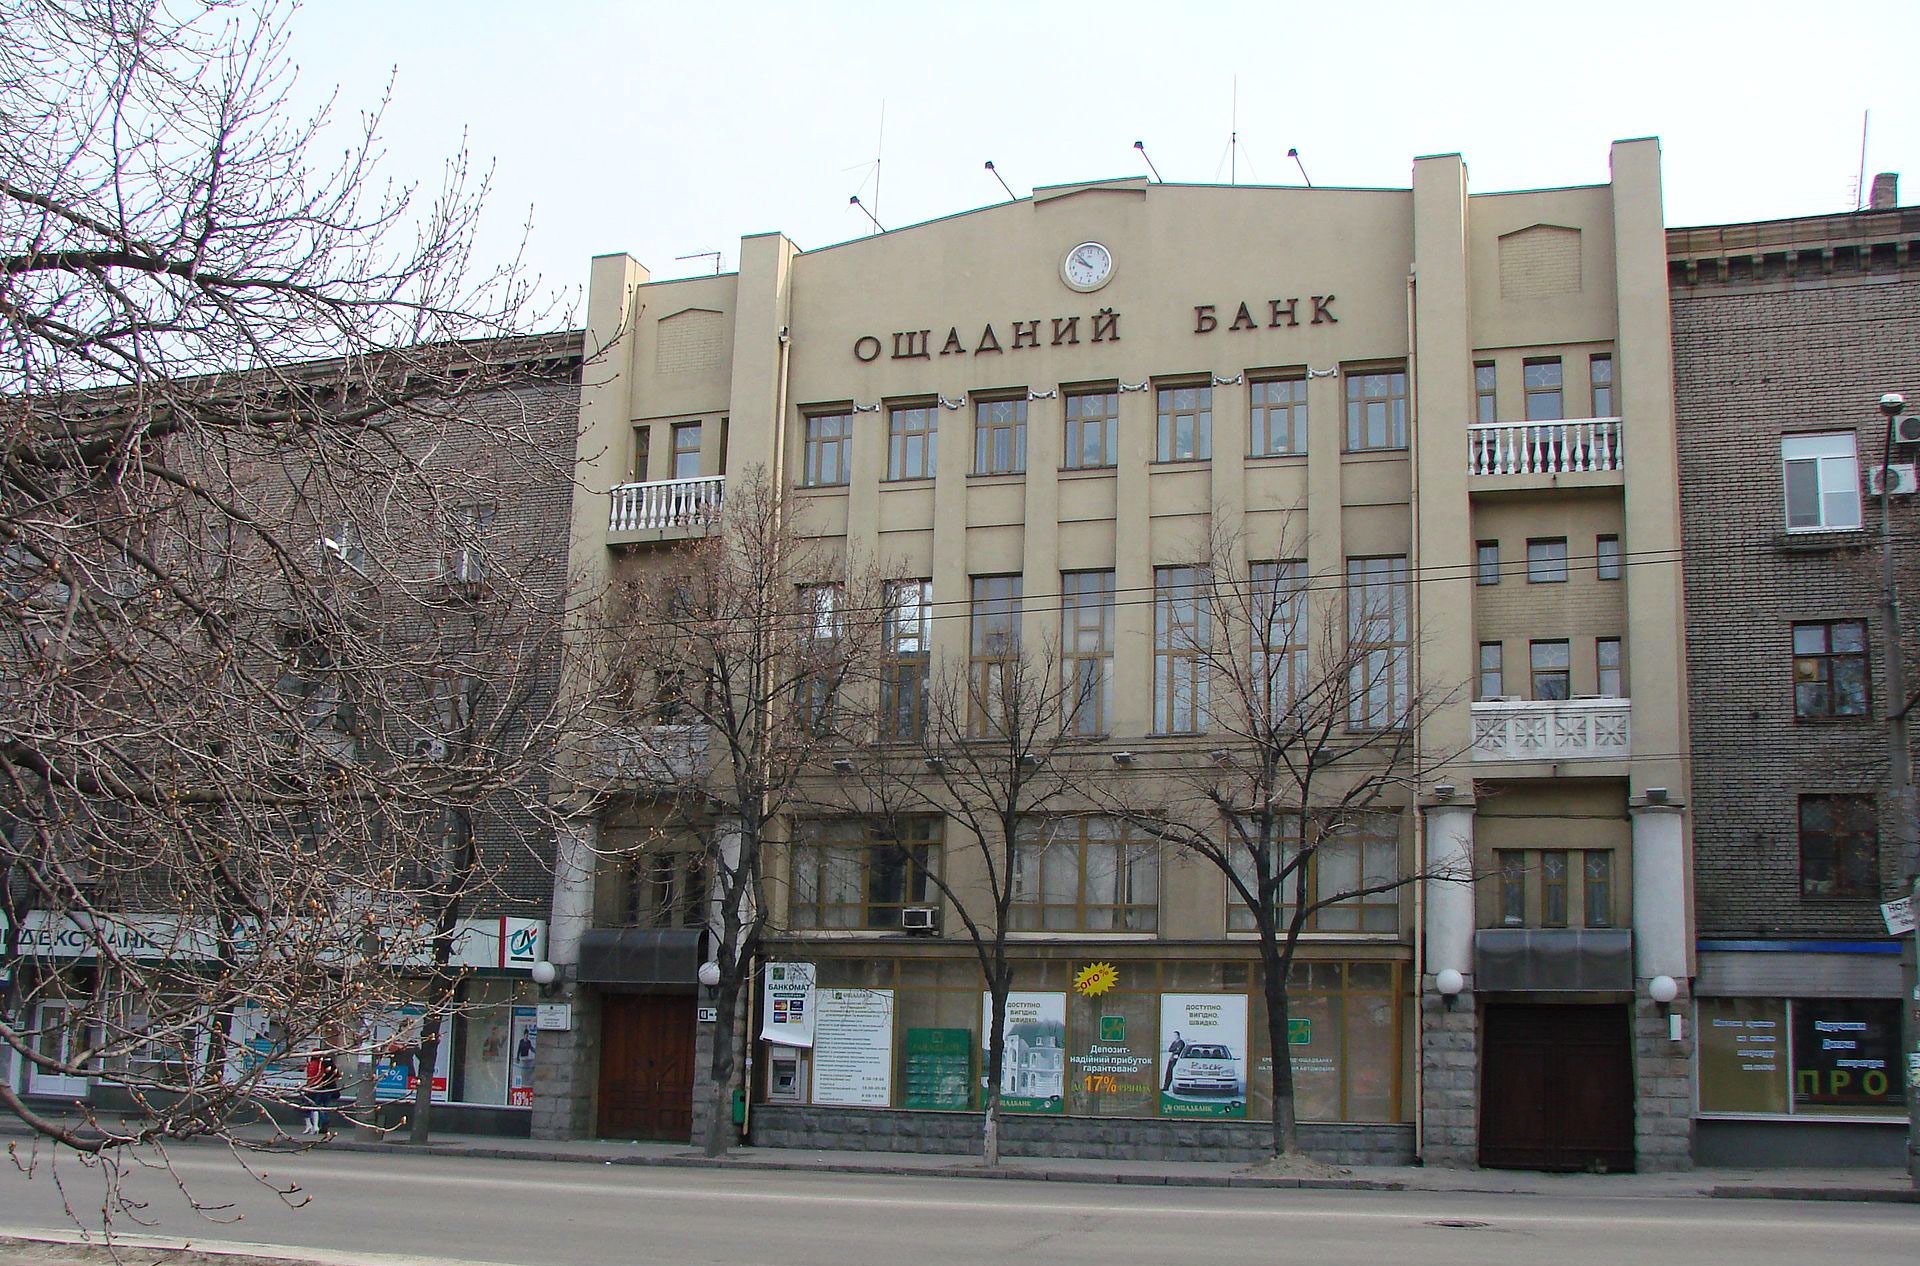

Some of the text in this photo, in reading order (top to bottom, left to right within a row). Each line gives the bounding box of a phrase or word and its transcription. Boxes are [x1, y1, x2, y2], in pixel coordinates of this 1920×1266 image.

[853, 294, 1338, 362] ОЩАДНИЙ БАНК
[768, 983, 811, 991] БАНКОМАТ
[1069, 1055, 1153, 1066] надійний прибуток
[1083, 1065, 1138, 1074] гарантовано
[1084, 1075, 1117, 1093] 17%
[1796, 1069, 1889, 1096] ПРО
